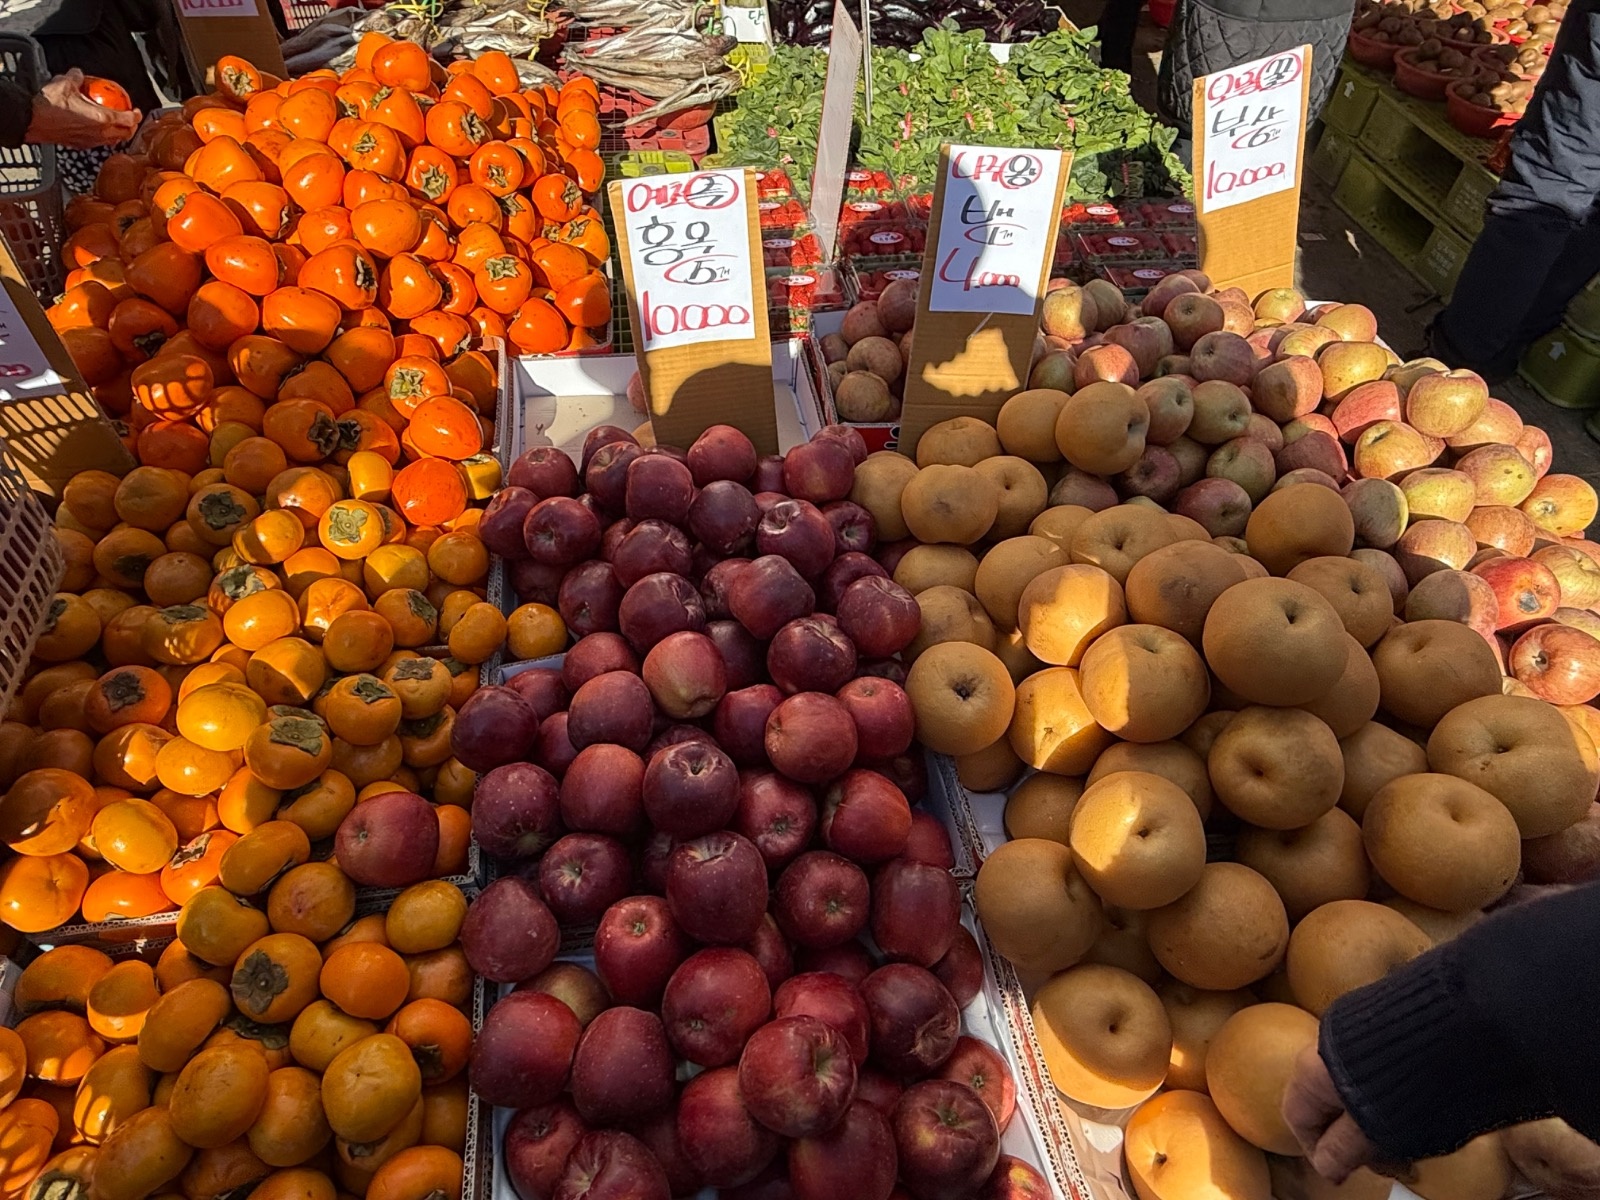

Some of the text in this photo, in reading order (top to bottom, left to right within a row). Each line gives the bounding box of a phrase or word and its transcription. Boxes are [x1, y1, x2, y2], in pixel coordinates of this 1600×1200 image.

[1209, 105, 1285, 138] 부사
[960, 194, 1015, 225] 배
[636, 215, 718, 266] 홍옥
